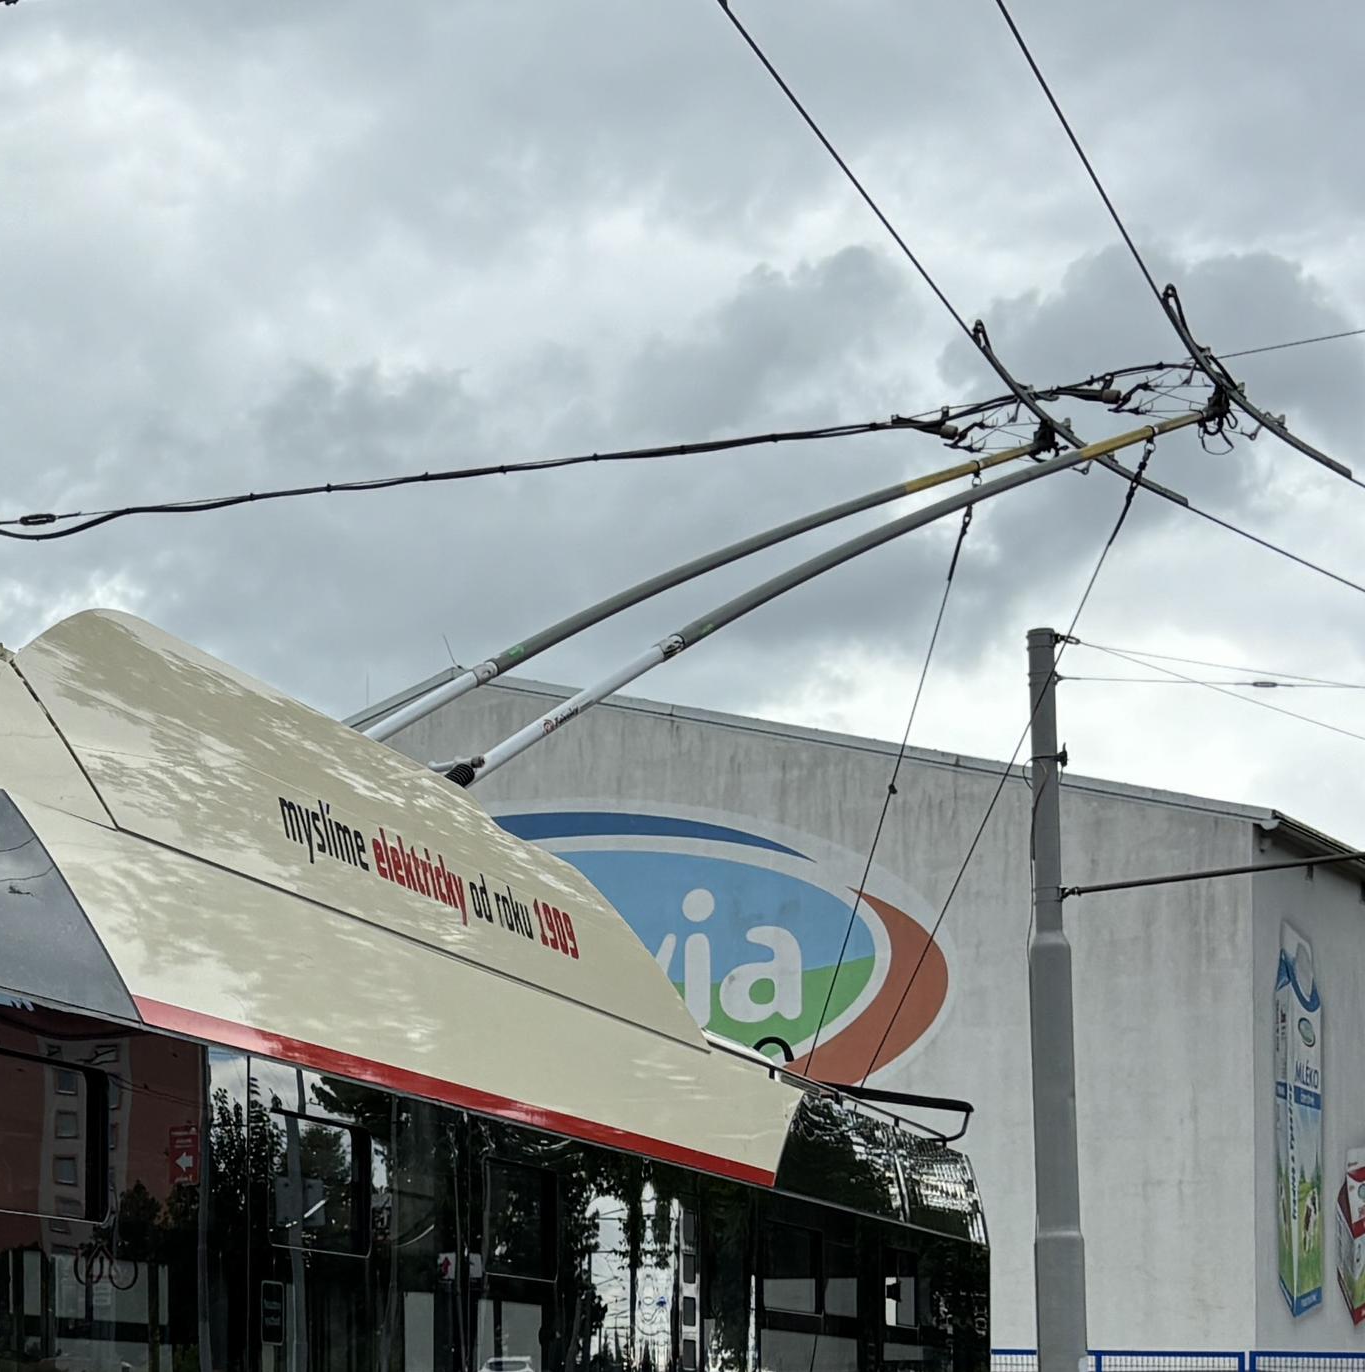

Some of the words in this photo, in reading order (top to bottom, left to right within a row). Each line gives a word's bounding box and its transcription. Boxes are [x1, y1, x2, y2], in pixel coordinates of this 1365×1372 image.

[278, 796, 370, 872] myslíme
[371, 827, 469, 927] elektricky
[469, 873, 494, 924] od
[494, 885, 534, 940] roku
[533, 897, 580, 960] 1909
